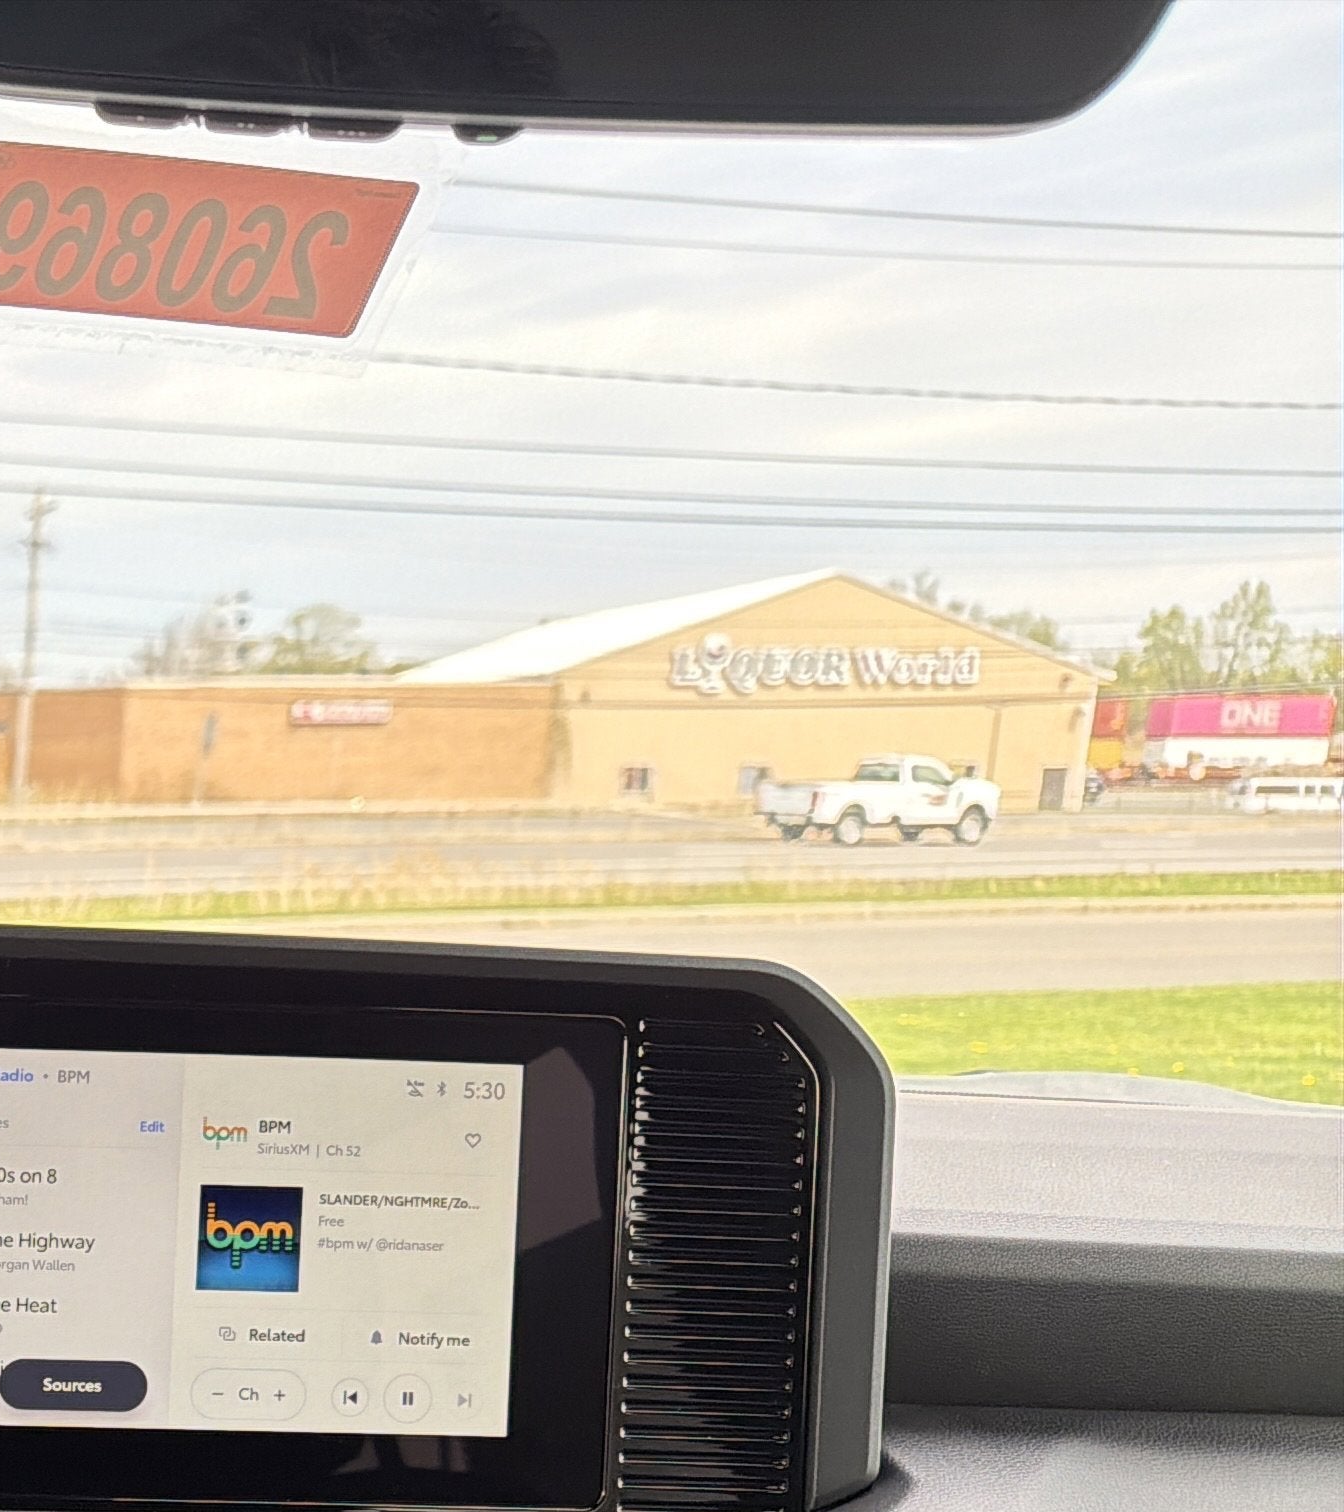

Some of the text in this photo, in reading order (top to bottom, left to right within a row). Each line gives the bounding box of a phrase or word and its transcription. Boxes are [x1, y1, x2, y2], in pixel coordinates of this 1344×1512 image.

[1221, 699, 1282, 728] ONE
[57, 1070, 90, 1084] BPM
[463, 1082, 506, 1100] 5:30
[139, 1121, 165, 1133] Edit
[203, 1116, 248, 1150] bpm
[258, 1120, 291, 1134] BPM
[257, 1143, 361, 1157] SiriusXM Ch 52
[20, 1172, 42, 1184] on
[47, 1169, 57, 1184] 8
[318, 1216, 345, 1227] Free
[206, 1200, 294, 1269] bpm
[18, 1233, 95, 1254] Highway
[317, 1238, 444, 1252] #bpm w/ @ridanaser
[32, 1259, 75, 1271] Wallen
[16, 1297, 57, 1313] Heat
[249, 1329, 306, 1343] Related
[398, 1332, 471, 1349] Notify me
[42, 1378, 102, 1393] Sources
[238, 1388, 259, 1402] Ch
